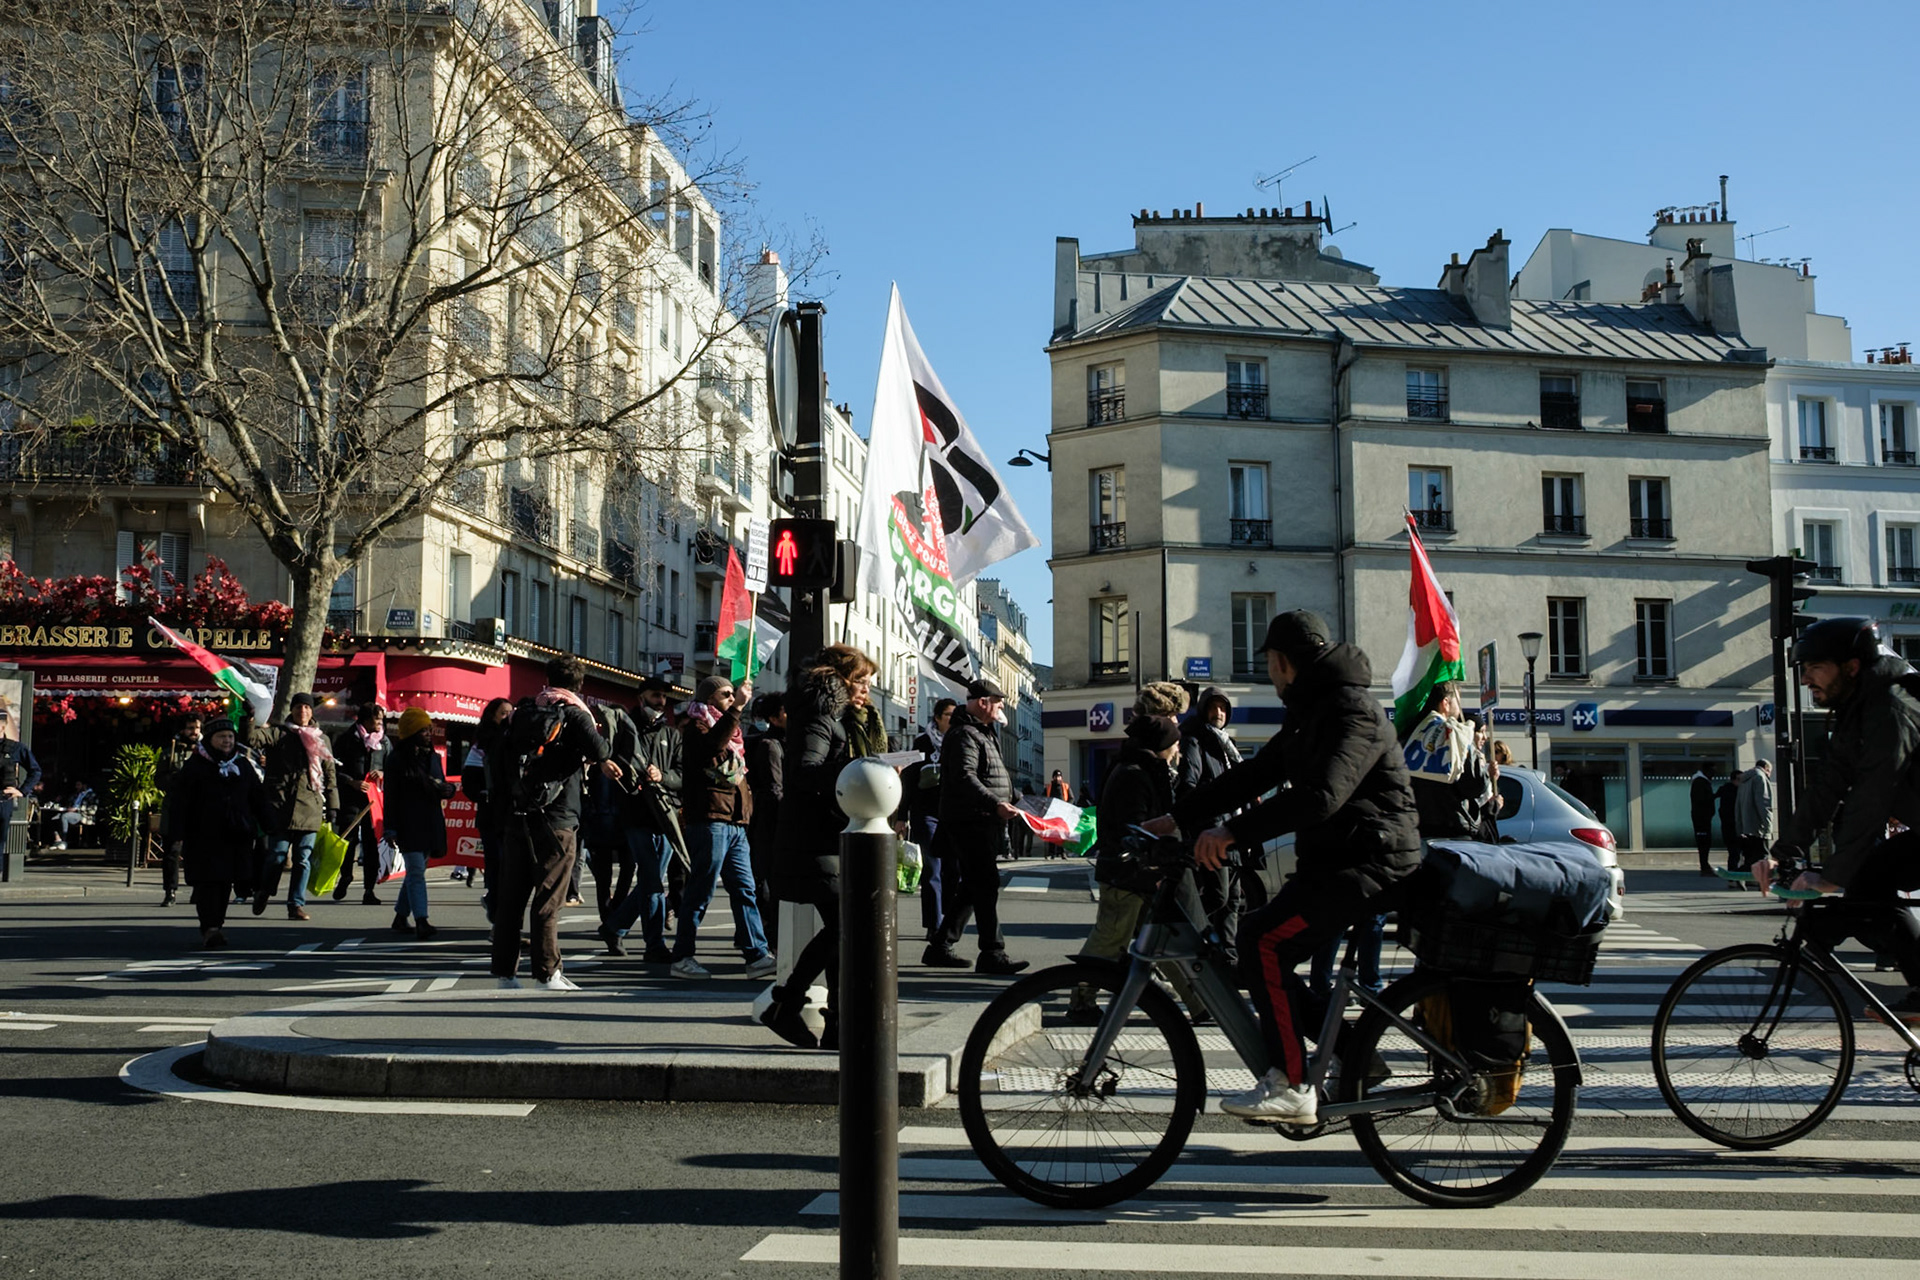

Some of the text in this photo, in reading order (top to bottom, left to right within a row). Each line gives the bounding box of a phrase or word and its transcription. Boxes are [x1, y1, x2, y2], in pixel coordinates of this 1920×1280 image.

[1889, 603, 1920, 617] PH
[0, 625, 133, 648] BRASSERIE
[57, 675, 107, 683] BRASSERIE
[330, 676, 343, 684] 7/7
[450, 801, 471, 811] ans
